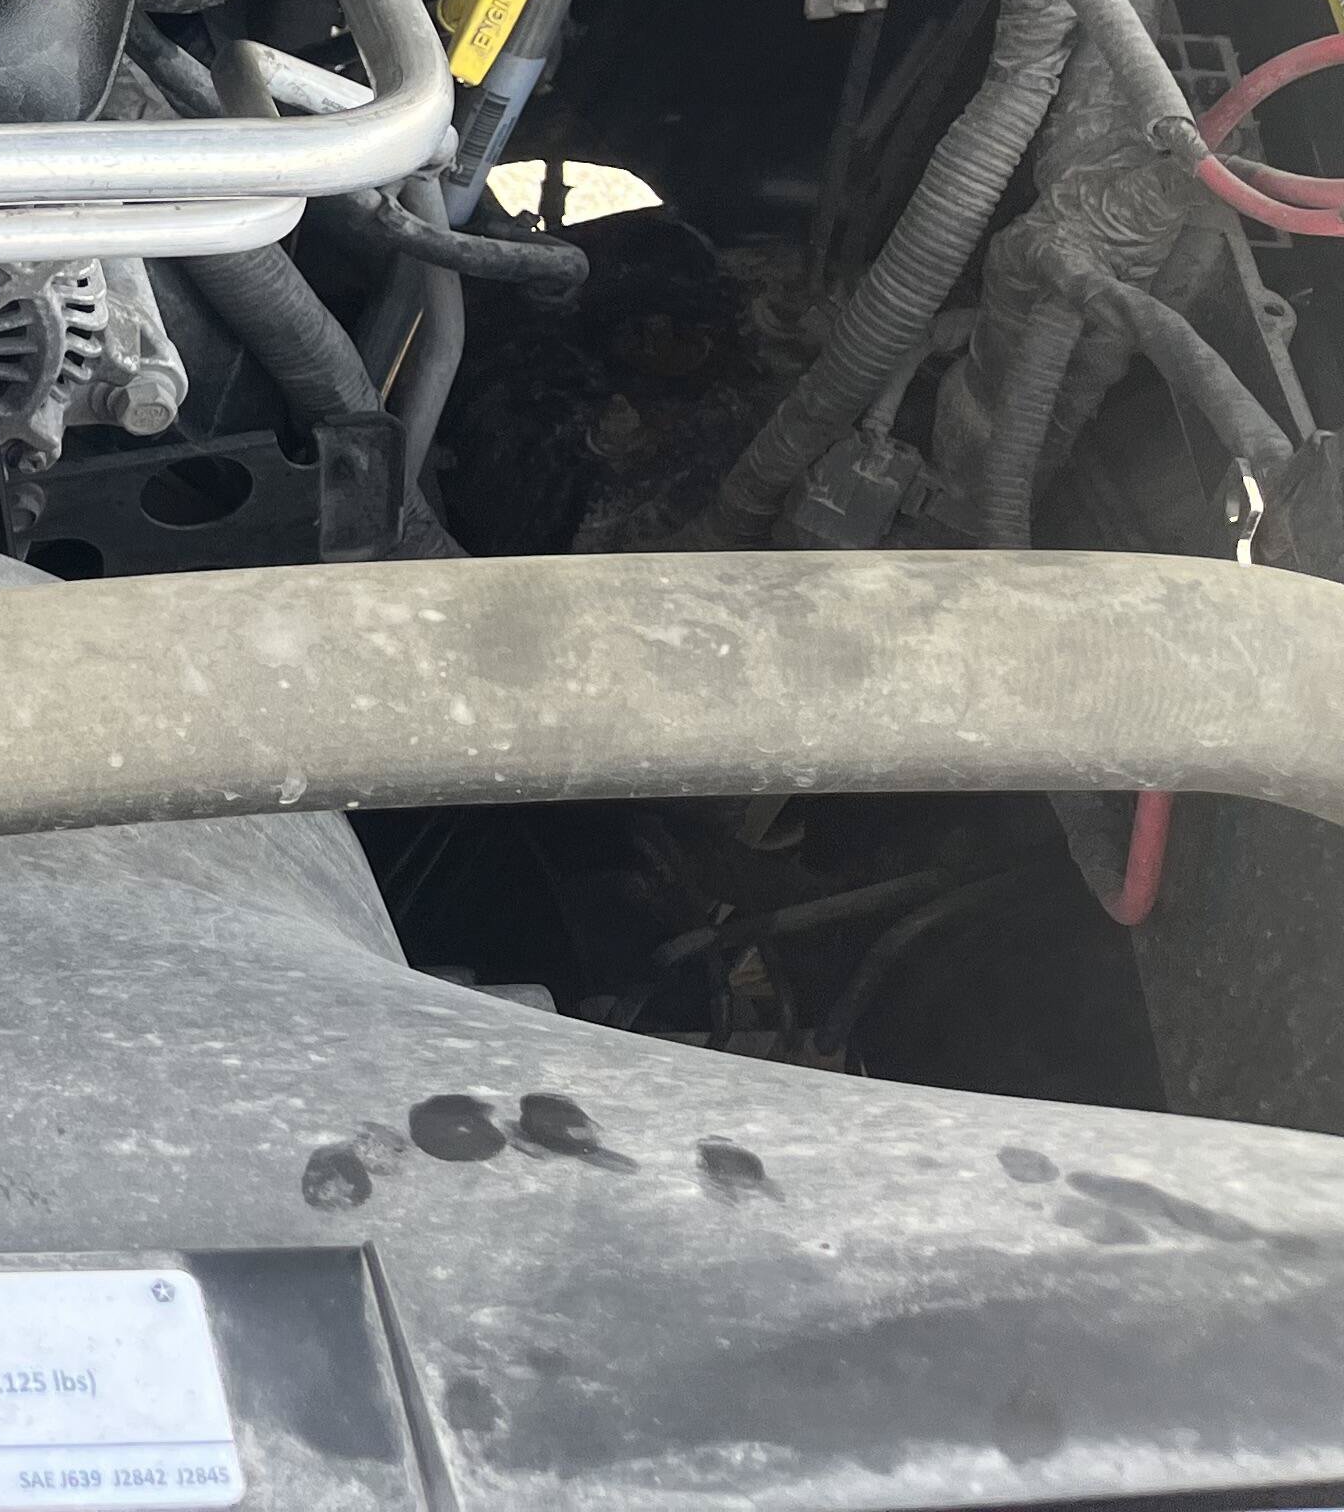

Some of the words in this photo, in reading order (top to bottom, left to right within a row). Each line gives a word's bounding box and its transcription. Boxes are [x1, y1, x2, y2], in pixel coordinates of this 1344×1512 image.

[54, 1369, 98, 1397] lbs)
[19, 1471, 54, 1488] SAE
[59, 1470, 102, 1489] J639
[113, 1468, 167, 1487] J2842
[177, 1466, 230, 1485] J2845
